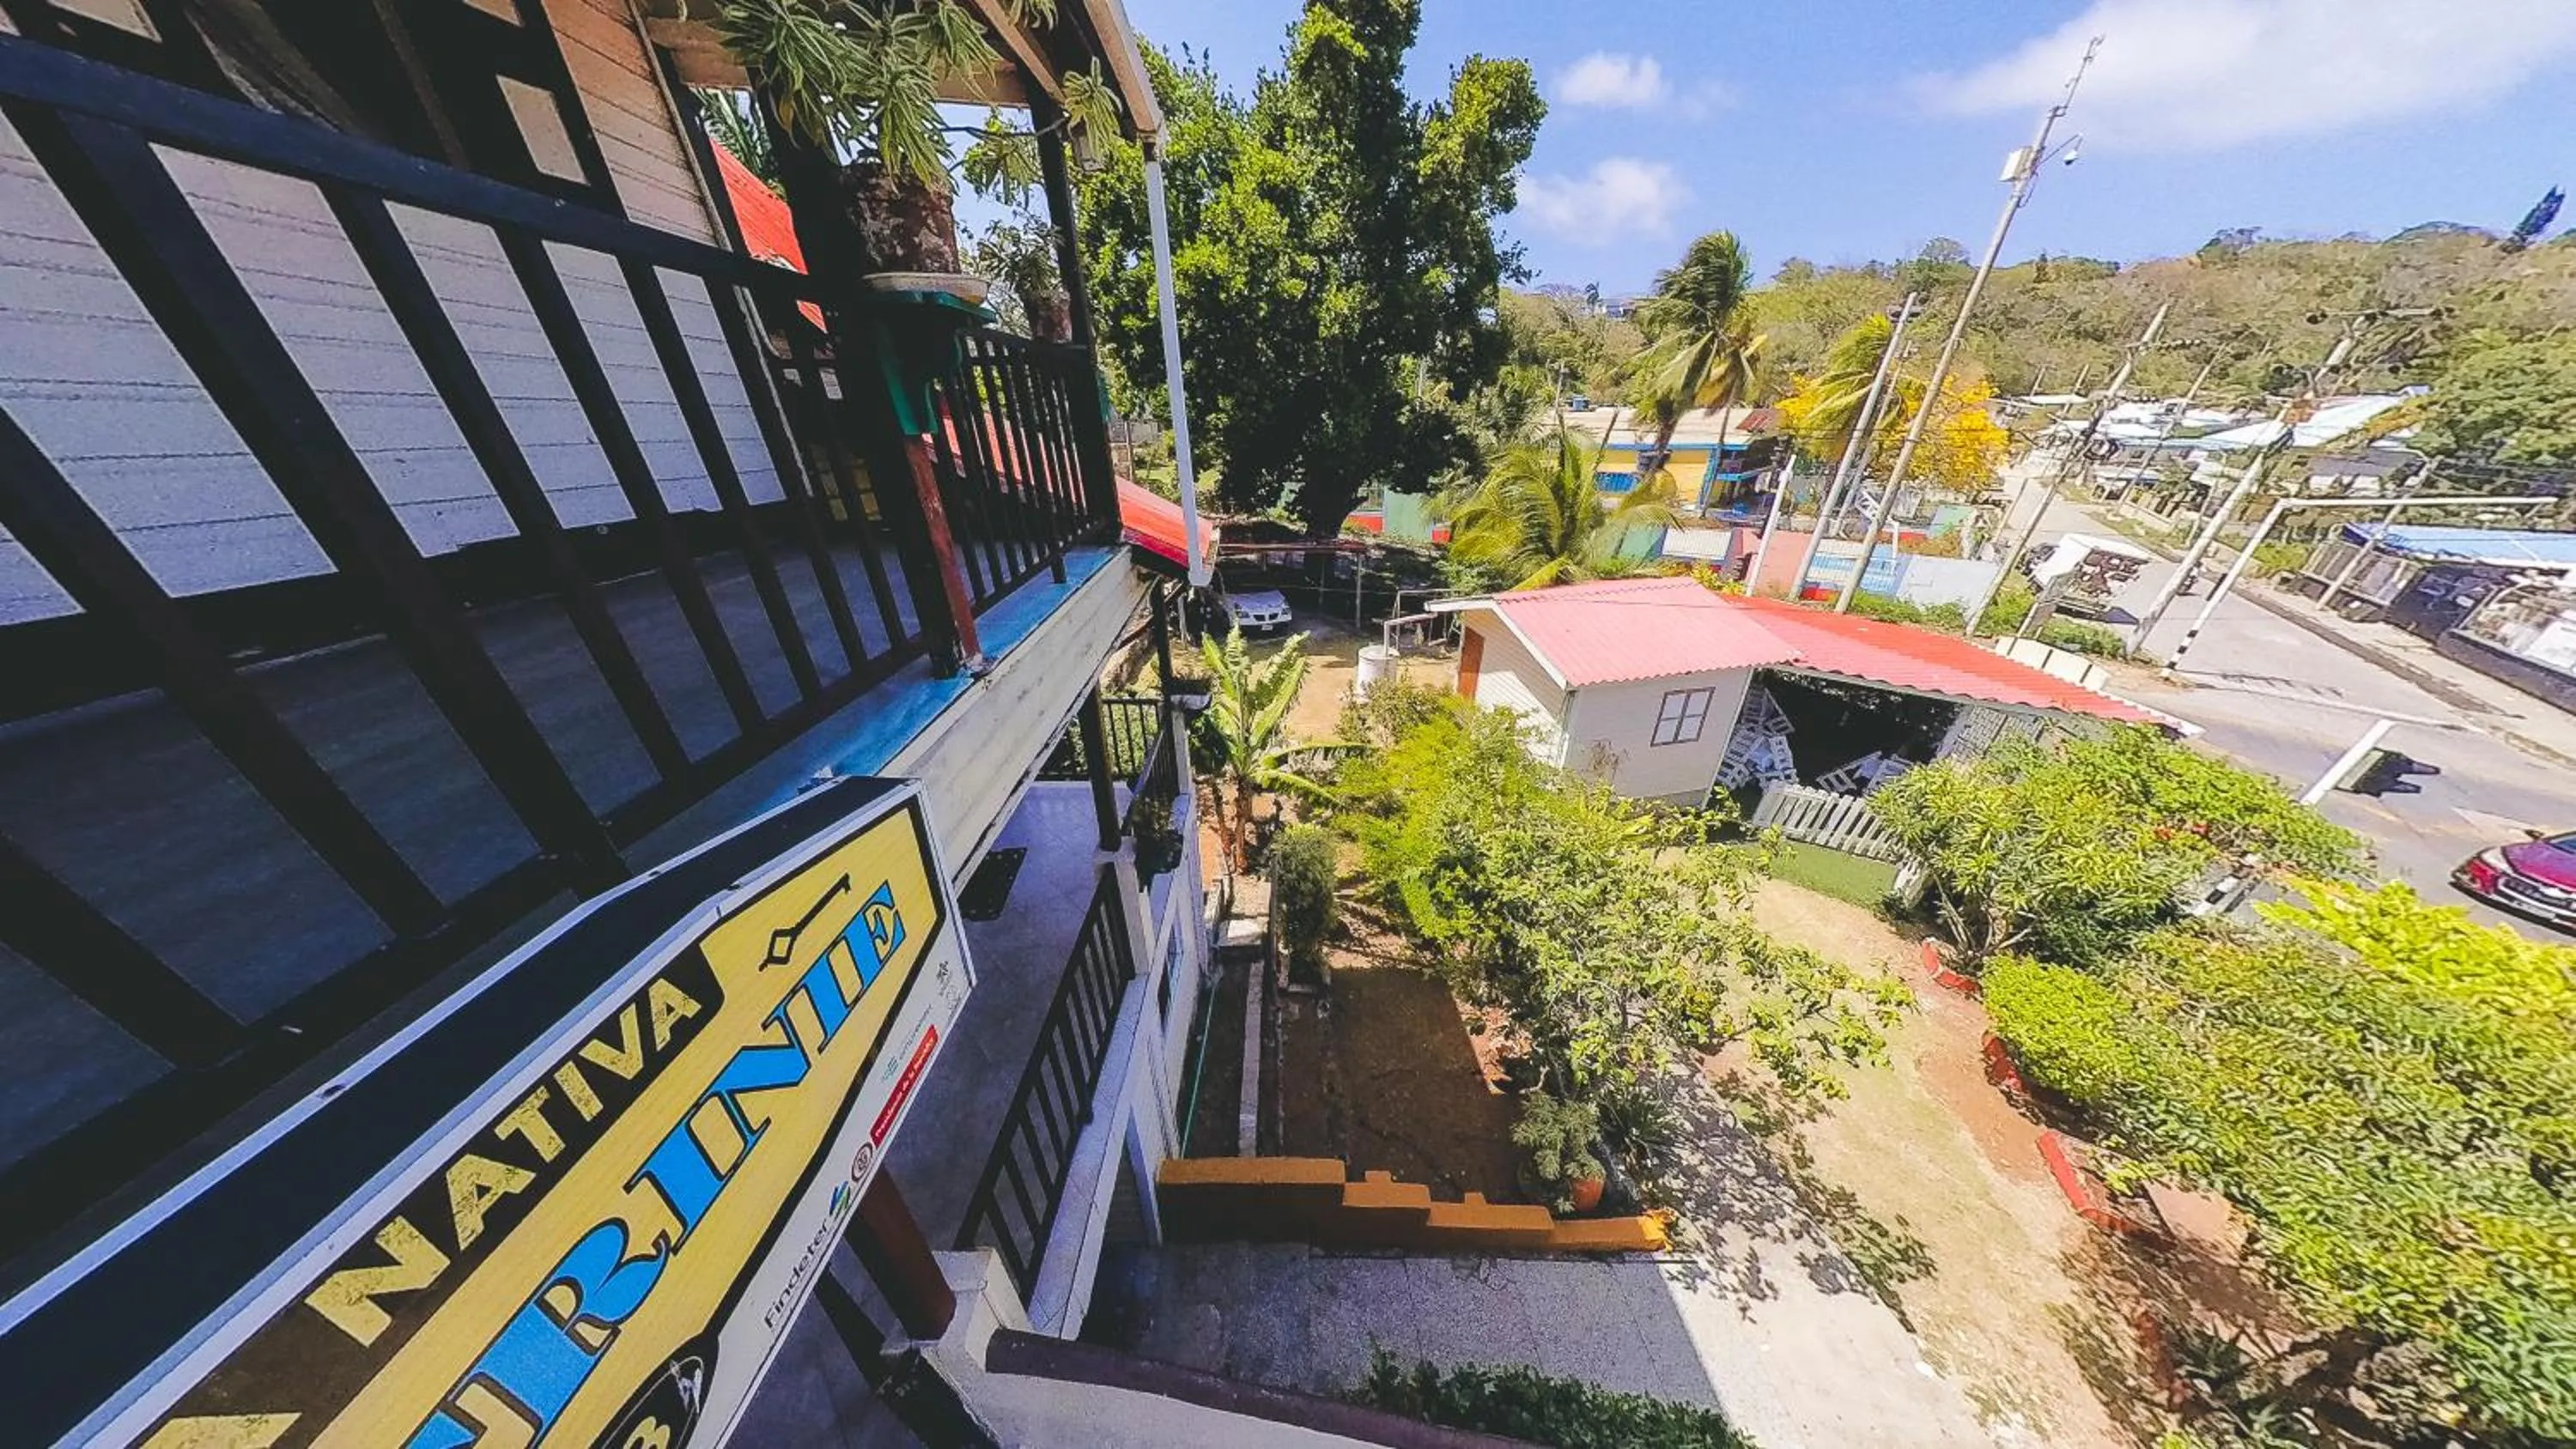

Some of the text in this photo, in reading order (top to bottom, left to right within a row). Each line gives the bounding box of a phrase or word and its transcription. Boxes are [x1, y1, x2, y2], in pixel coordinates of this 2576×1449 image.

[304, 978, 702, 1348] NATIVA
[404, 880, 907, 1449] RINIE
[763, 1218, 828, 1331] Findeter
